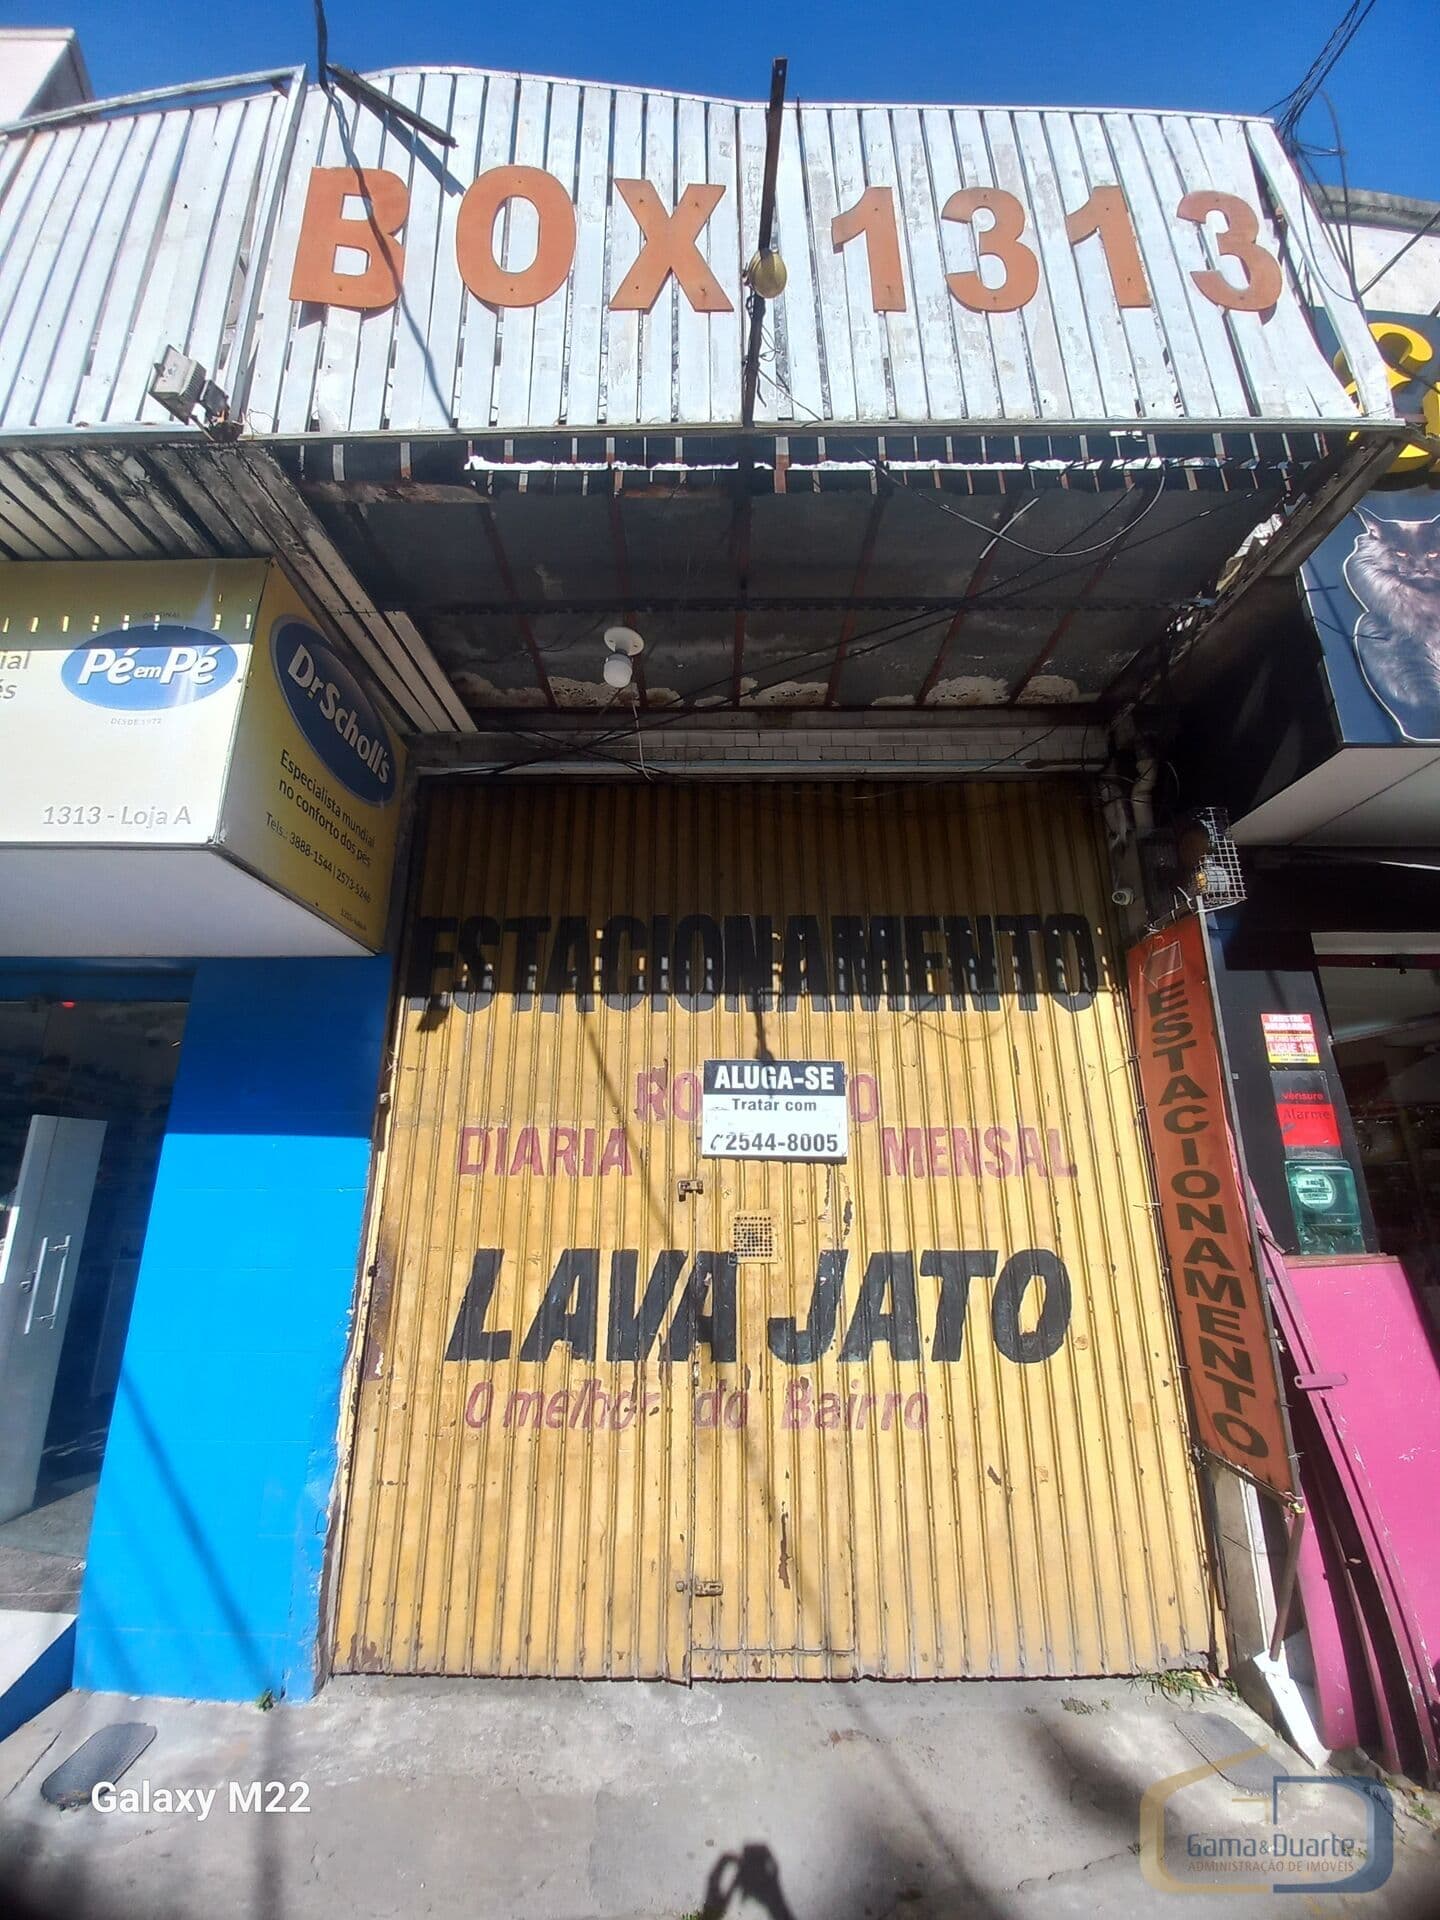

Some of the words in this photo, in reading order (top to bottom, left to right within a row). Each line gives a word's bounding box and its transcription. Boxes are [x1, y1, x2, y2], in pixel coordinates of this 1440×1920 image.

[289, 165, 735, 312] BOX
[831, 186, 1282, 312] 1313
[77, 647, 140, 685] Pé
[133, 664, 160, 679] em
[159, 647, 223, 686] Pé
[42, 806, 101, 825] 1313
[121, 806, 168, 829] Loja
[173, 806, 192, 825] A
[279, 778, 295, 800] no
[296, 794, 340, 840] conforto
[340, 832, 356, 855] dos
[280, 749, 341, 817] Especialista
[342, 812, 376, 849] mundial
[404, 912, 1098, 1014] ESTACIONAMENTO
[714, 1065, 835, 1091] ALUGA-SE
[732, 1097, 779, 1111] Tratar
[785, 1101, 817, 1112] com
[457, 1127, 633, 1177] DIARIA
[882, 1127, 1078, 1178] MENSAL
[725, 1132, 838, 1153] 2544-8005
[1147, 980, 1269, 1459] ESTACIONAMENTO
[444, 1248, 738, 1363] LAVA
[767, 1248, 1072, 1364] JATO
[465, 1380, 495, 1429] O
[503, 1378, 661, 1430] melhor
[781, 1376, 929, 1431] Bairro
